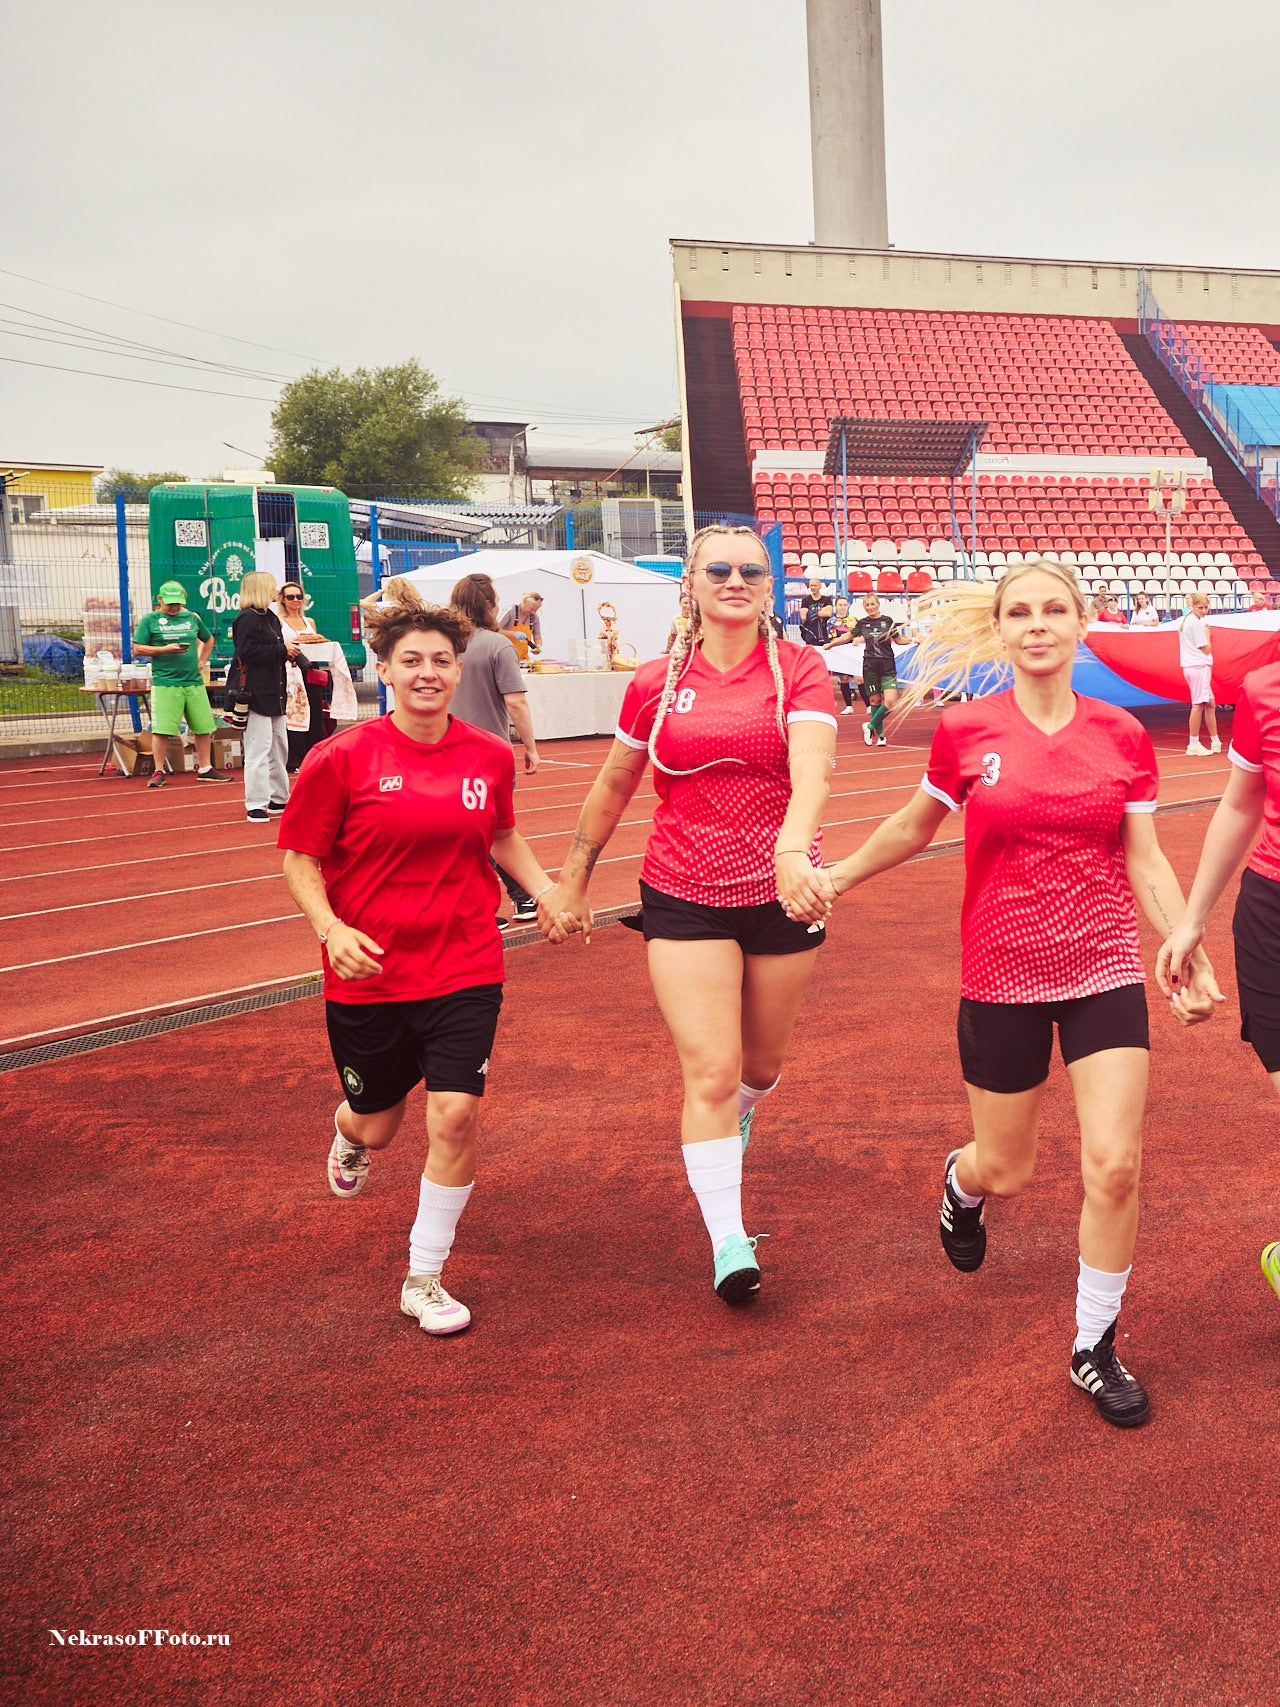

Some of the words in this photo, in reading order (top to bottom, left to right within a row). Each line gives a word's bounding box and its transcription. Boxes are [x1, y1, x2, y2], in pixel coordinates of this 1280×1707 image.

[869, 684, 876, 693] 11
[981, 752, 1002, 787] 3
[461, 777, 488, 811] 69
